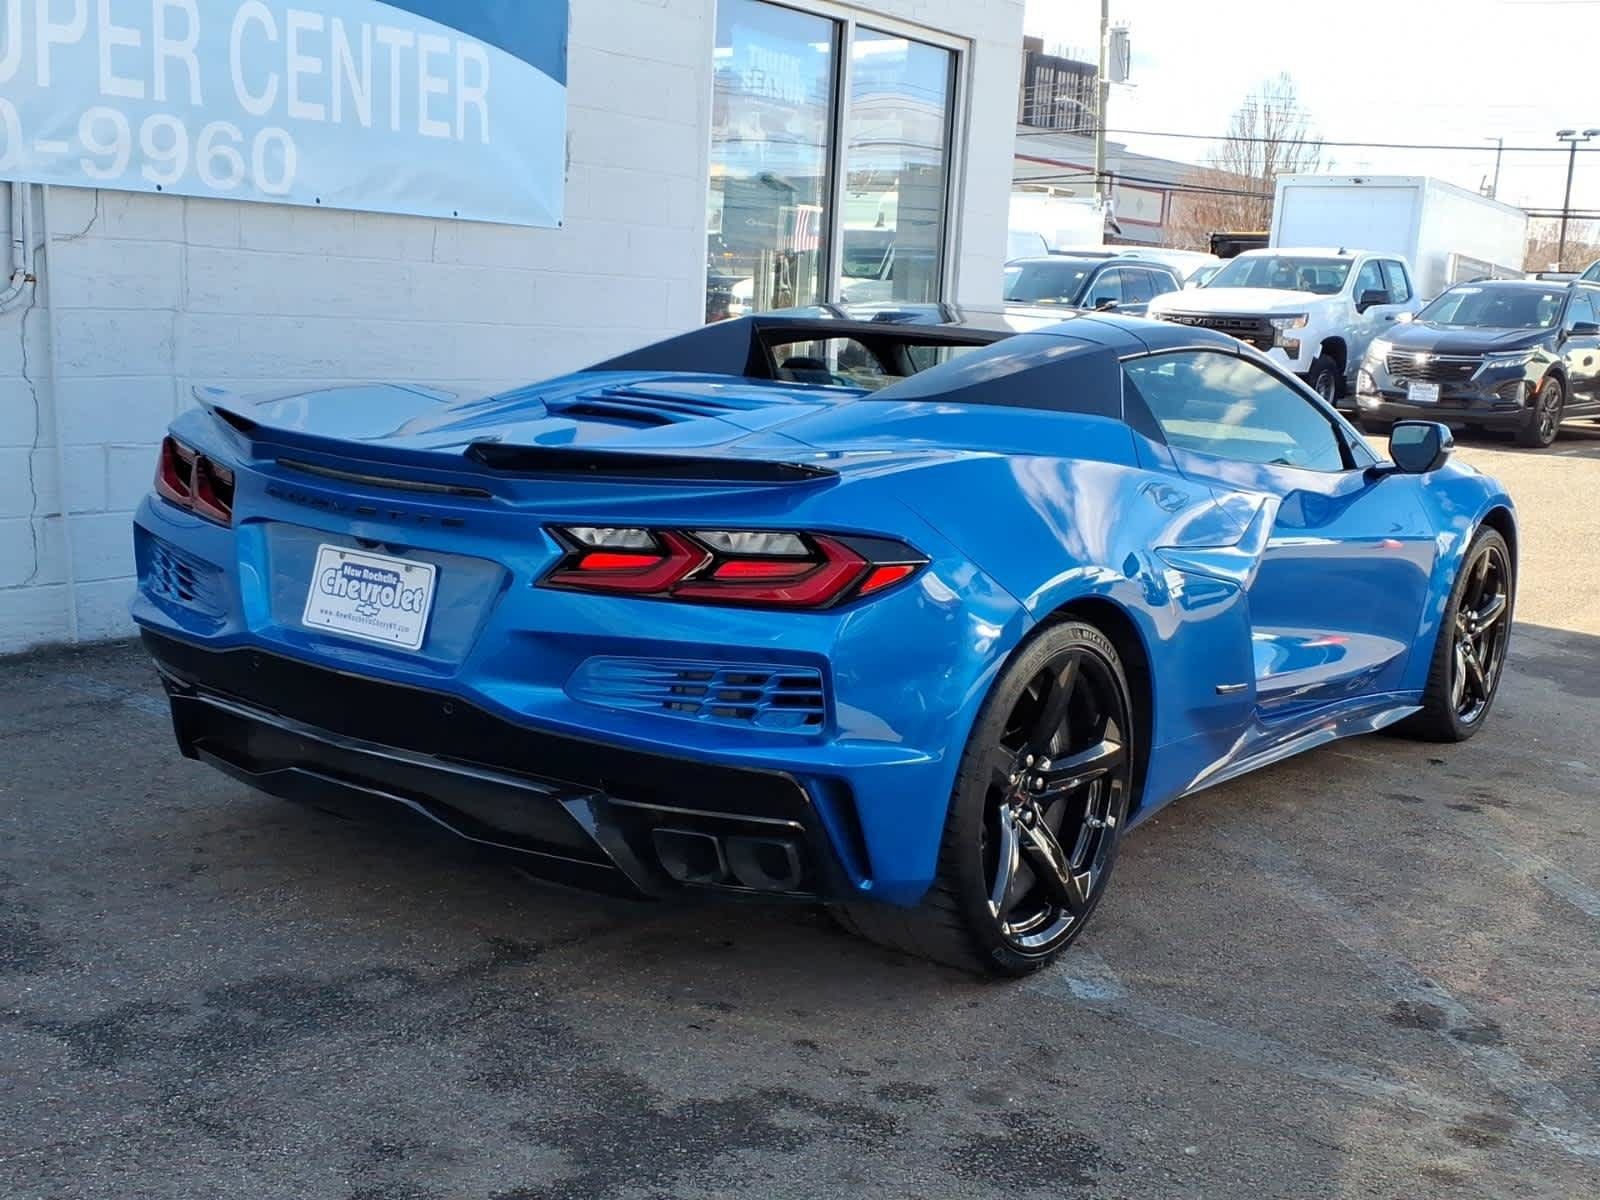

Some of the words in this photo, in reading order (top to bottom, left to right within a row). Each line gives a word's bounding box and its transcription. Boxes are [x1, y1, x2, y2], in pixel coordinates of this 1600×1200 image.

[230, 0, 490, 144] CENTER
[320, 567, 424, 613] Chevrolet
[342, 564, 362, 578] New
